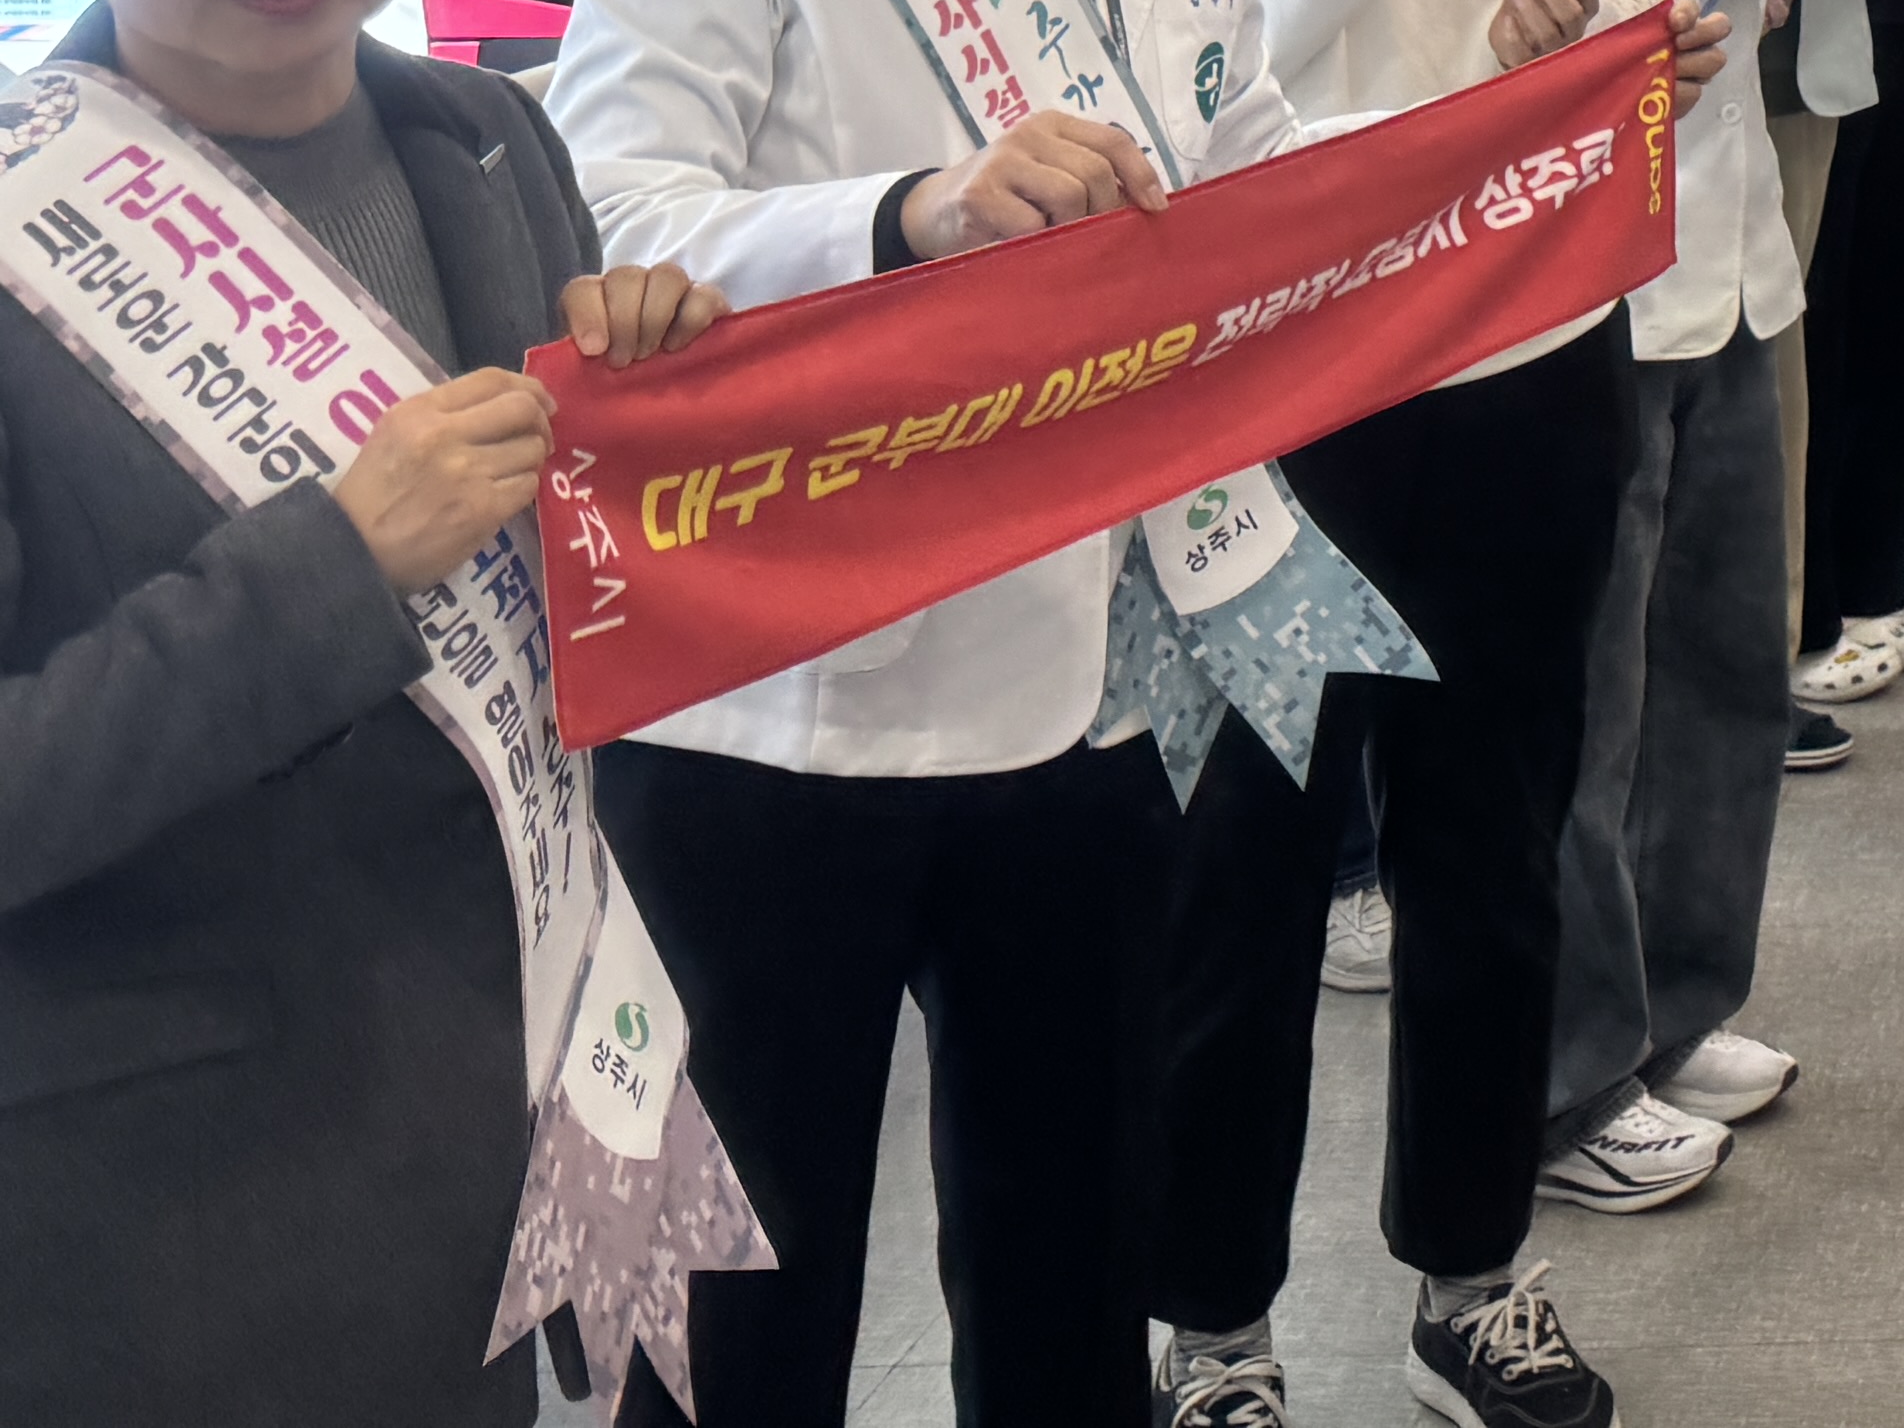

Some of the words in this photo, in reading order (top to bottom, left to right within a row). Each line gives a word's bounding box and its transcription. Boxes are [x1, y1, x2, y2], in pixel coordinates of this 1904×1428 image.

[22, 198, 193, 354] 새로운
[83, 144, 352, 383] 군사시설
[641, 446, 795, 552] 대구
[806, 383, 1024, 501] 군부대
[1020, 323, 1198, 428] 이전은
[1191, 258, 1352, 367] 전략적
[551, 447, 627, 642] 상주시
[1185, 508, 1259, 573] 상주시
[592, 1037, 647, 1111] 상주시
